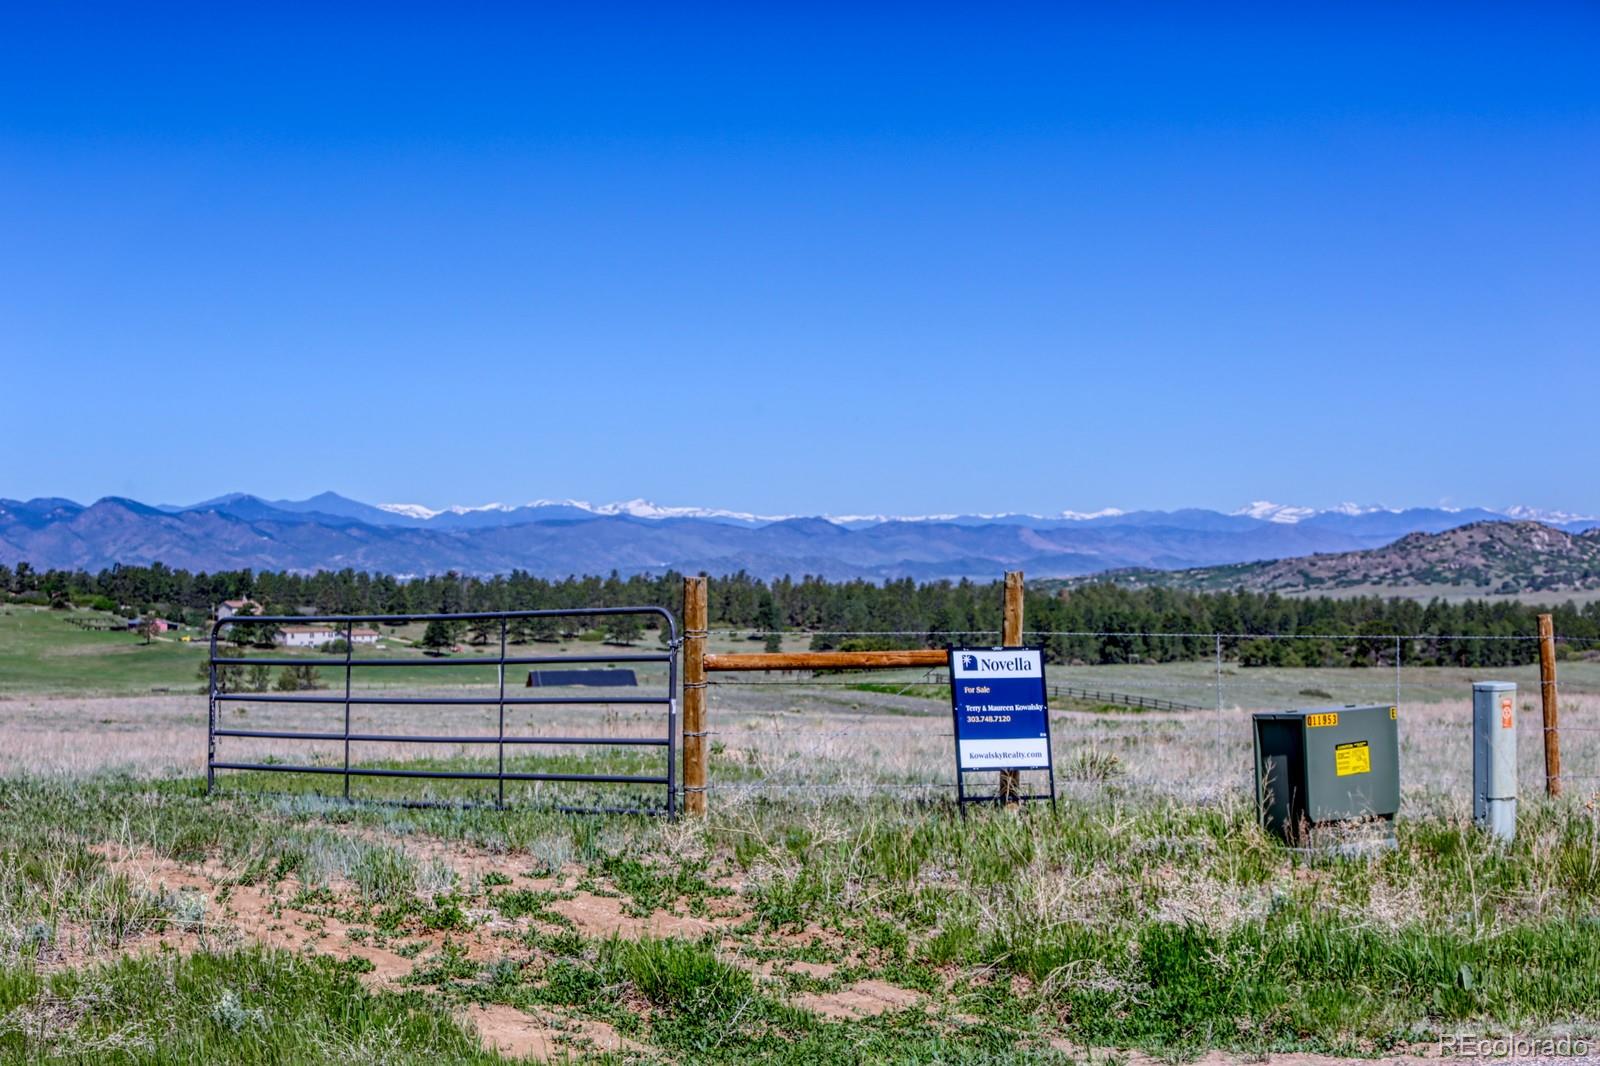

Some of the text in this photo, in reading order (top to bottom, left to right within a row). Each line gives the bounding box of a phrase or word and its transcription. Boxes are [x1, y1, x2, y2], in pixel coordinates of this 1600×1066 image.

[981, 657, 1032, 672] Novella
[964, 686, 990, 694] For Sale
[965, 705, 981, 713] Terry
[988, 704, 1014, 712] Maureen
[1015, 703, 1044, 712] Kowalsky
[969, 751, 1043, 760] KowalskyRealty.com
